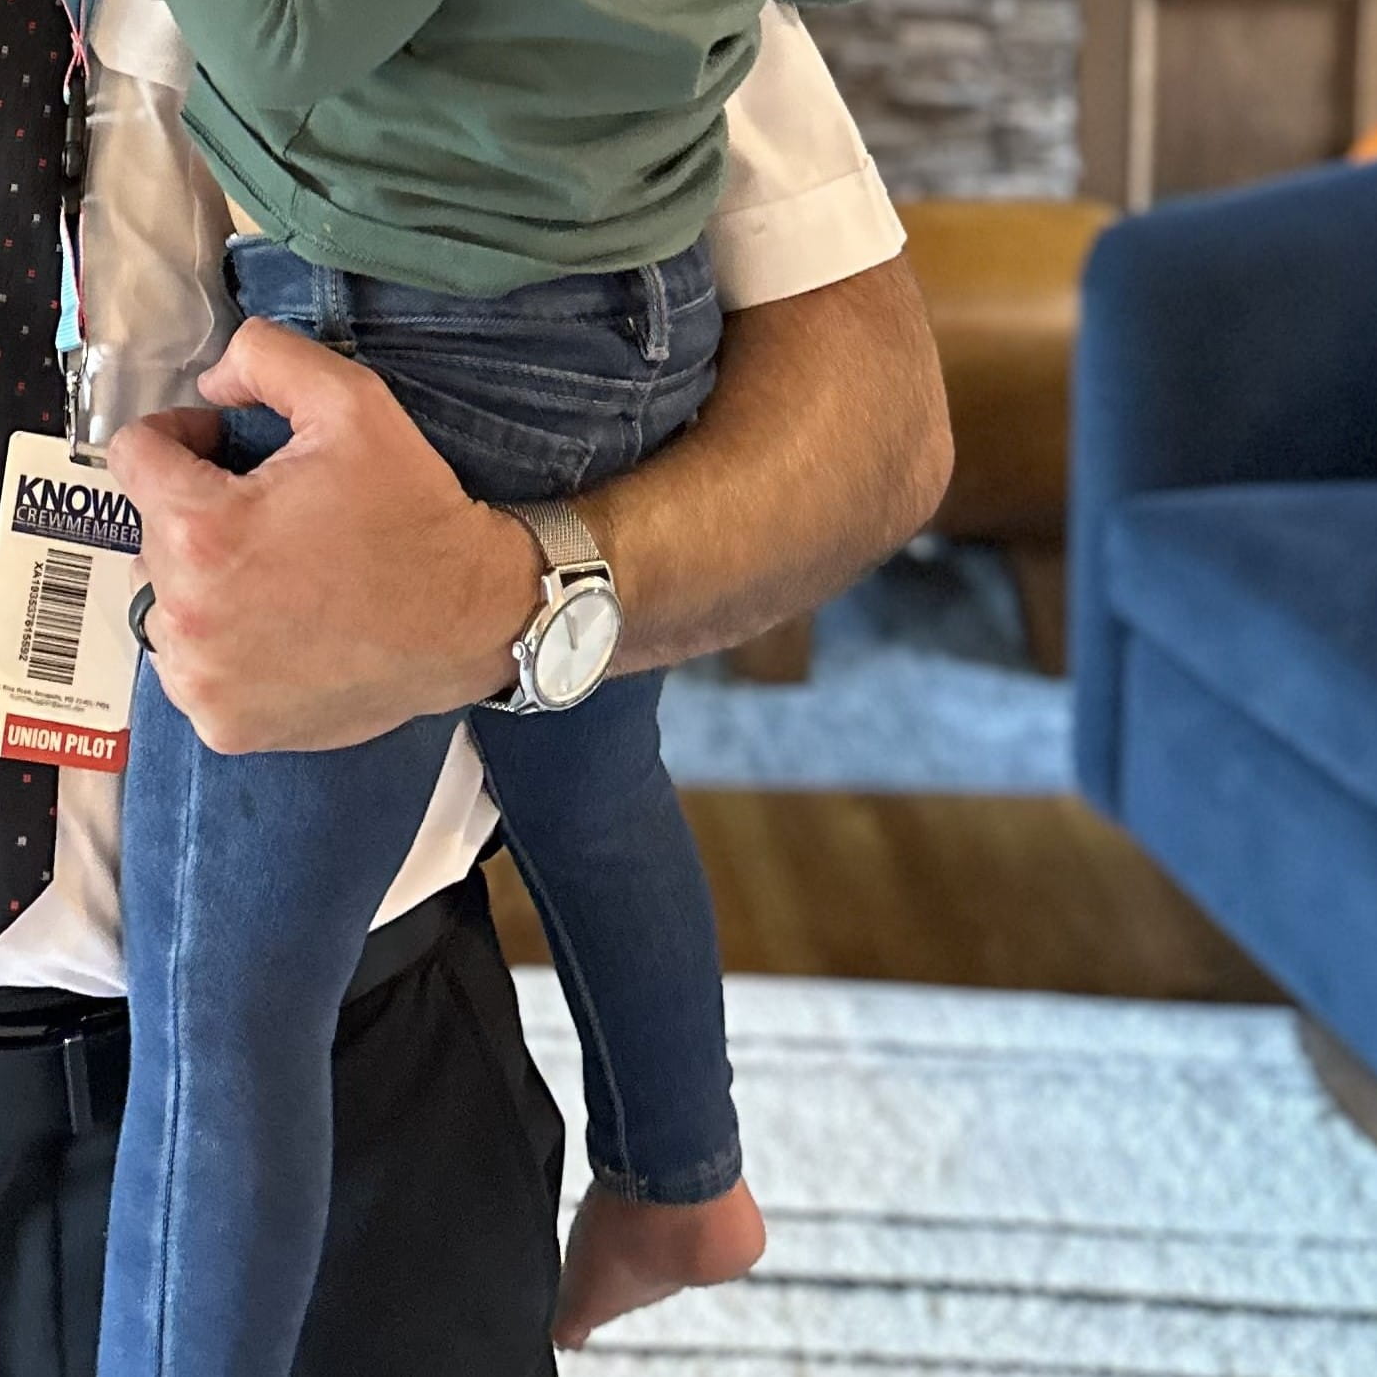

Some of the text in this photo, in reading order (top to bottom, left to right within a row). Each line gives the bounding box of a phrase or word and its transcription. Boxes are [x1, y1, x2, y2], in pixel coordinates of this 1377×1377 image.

[16, 505, 140, 543] CREWMEMBER
[7, 724, 117, 760] UNION PILOT
